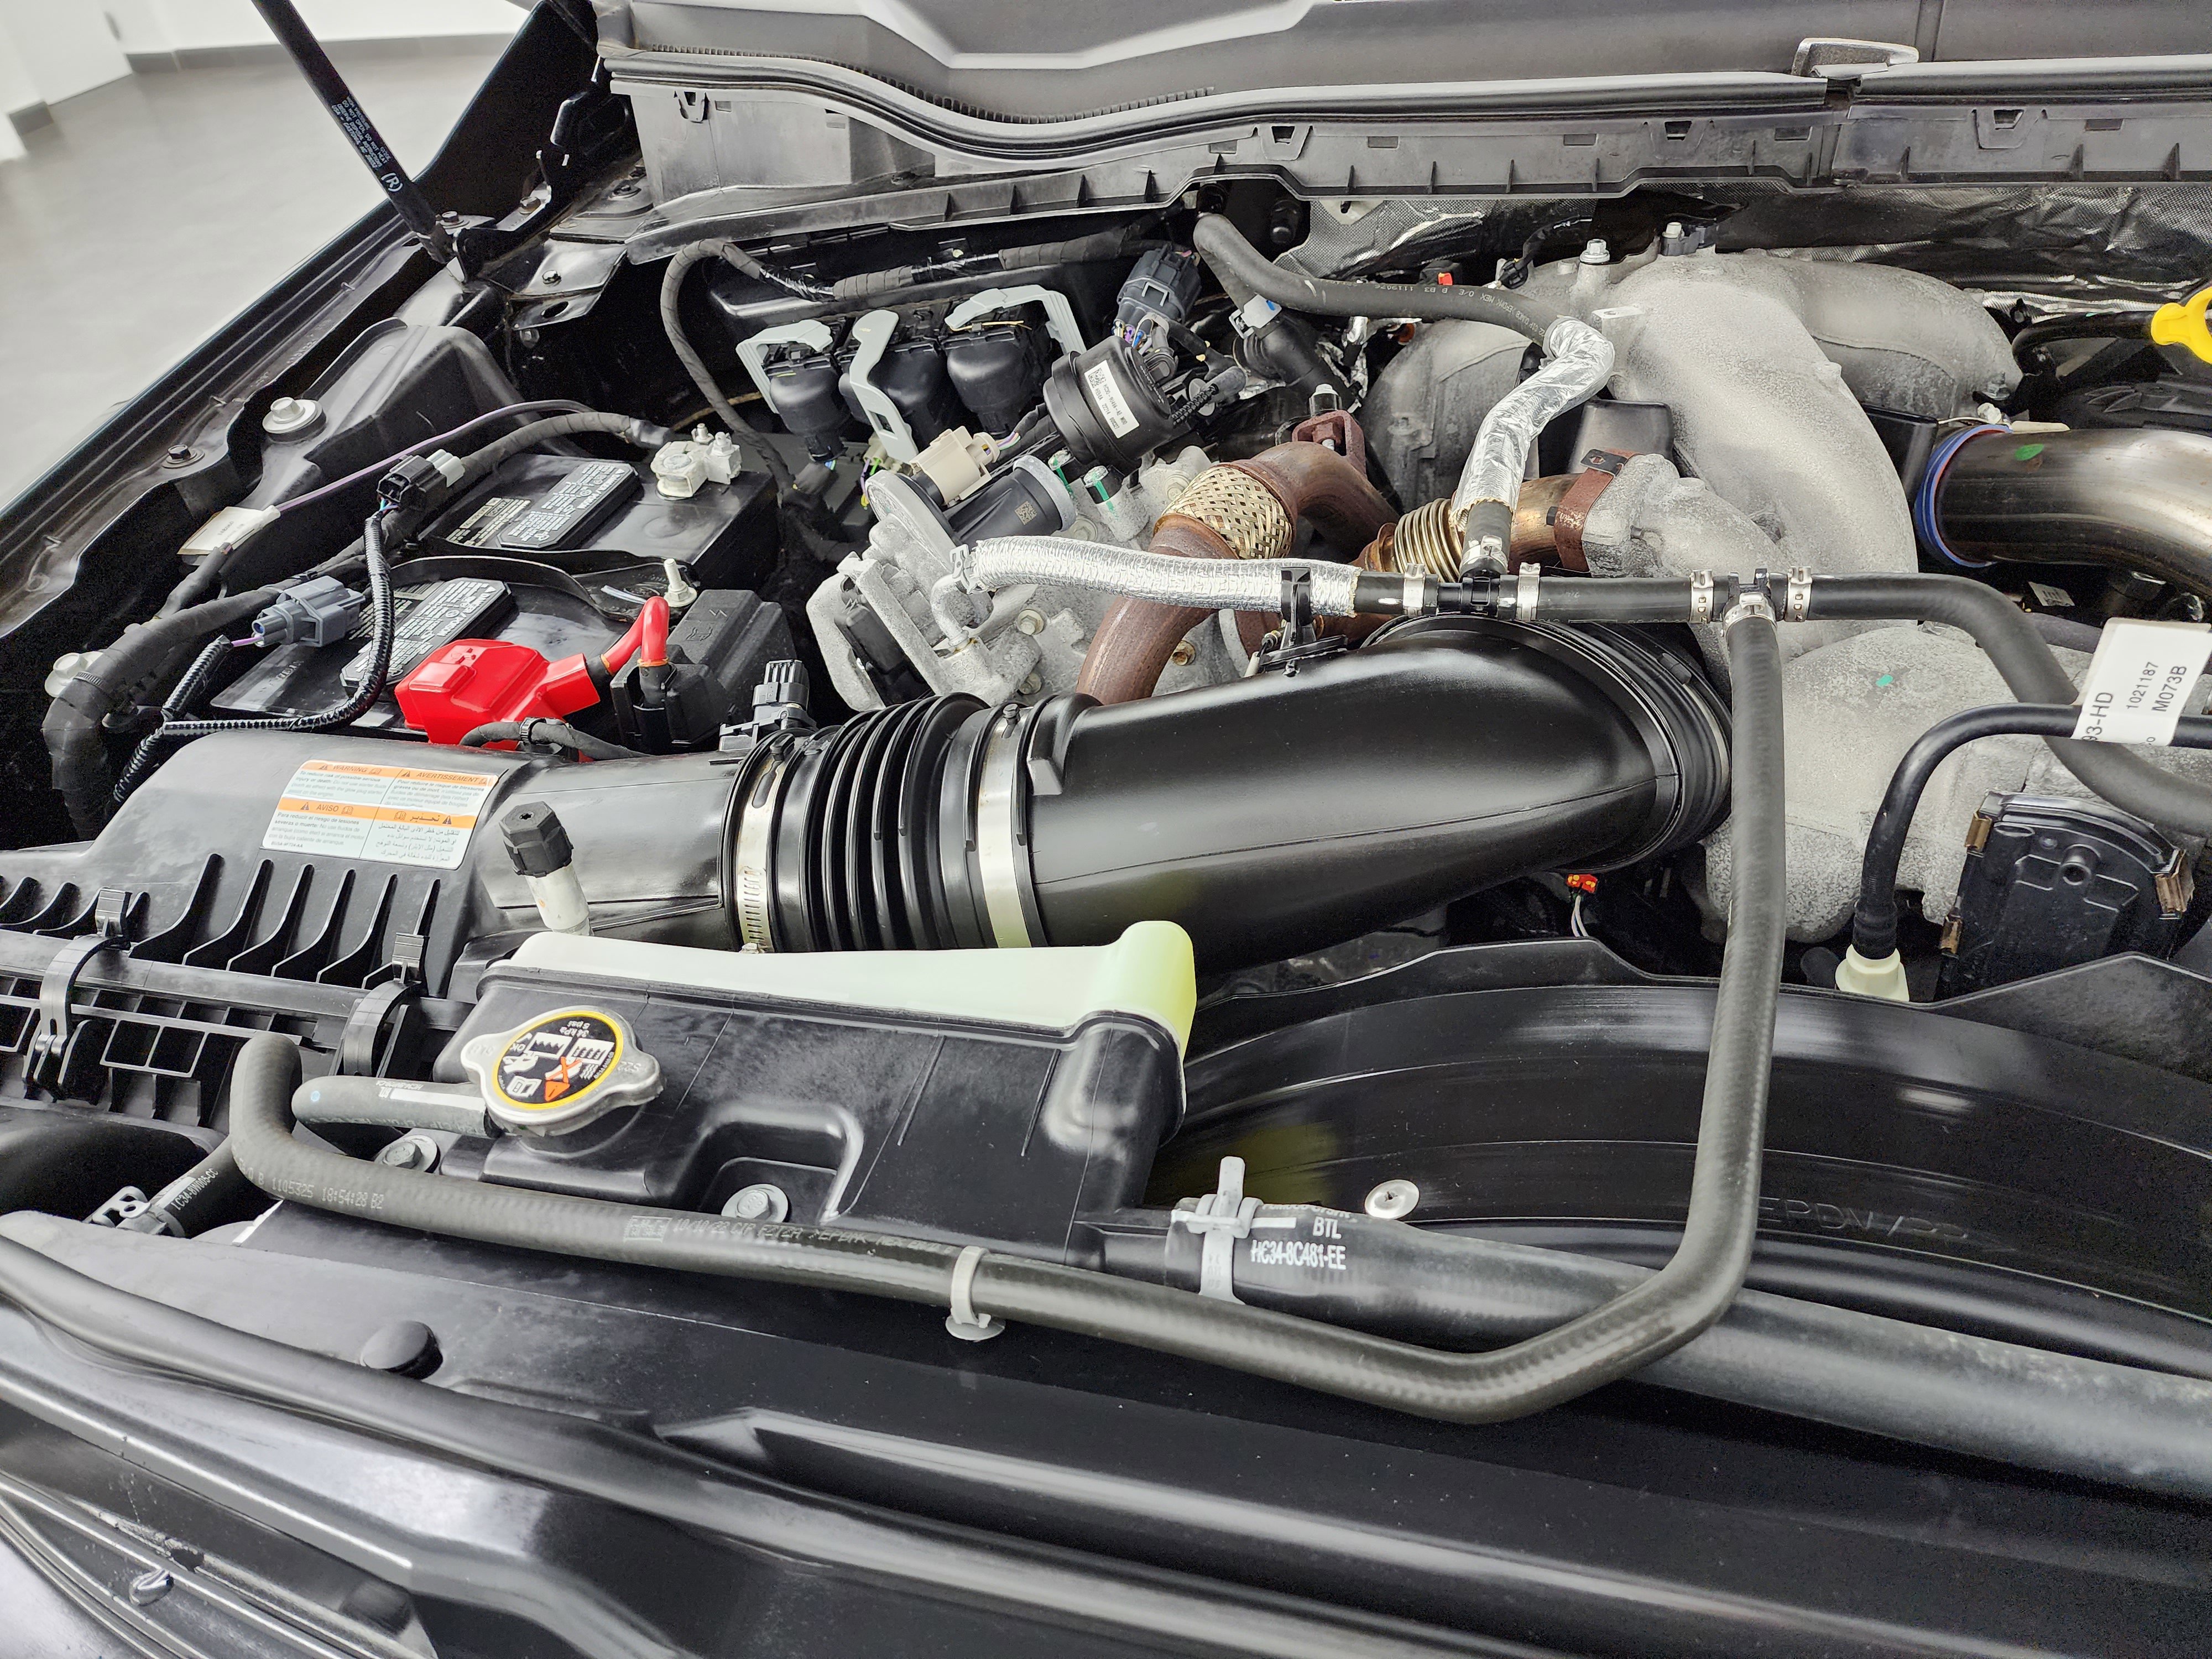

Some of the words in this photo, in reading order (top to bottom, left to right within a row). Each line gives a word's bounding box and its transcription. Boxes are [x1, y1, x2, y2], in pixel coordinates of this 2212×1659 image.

[463, 593, 491, 613] DANGER
[437, 617, 463, 637] POISON
[2126, 661, 2159, 709] 1021187
[2152, 665, 2187, 712] M073B
[416, 772, 479, 782] AVERTISSEMENT
[316, 804, 339, 812] AVISO
[557, 1021, 578, 1039] kPa
[566, 1015, 583, 1031] psi
[580, 1020, 590, 1031] 5
[575, 1026, 590, 1040] 34
[509, 1039, 526, 1055] OK
[170, 1165, 220, 1212] LC34-8W005-CC
[270, 1175, 316, 1199] 1105325
[321, 1186, 368, 1208] 18:54:28
[731, 1220, 757, 1237] CIP
[1312, 1215, 1343, 1240] BTL
[1249, 1236, 1348, 1270] HC34-8C481-EE
